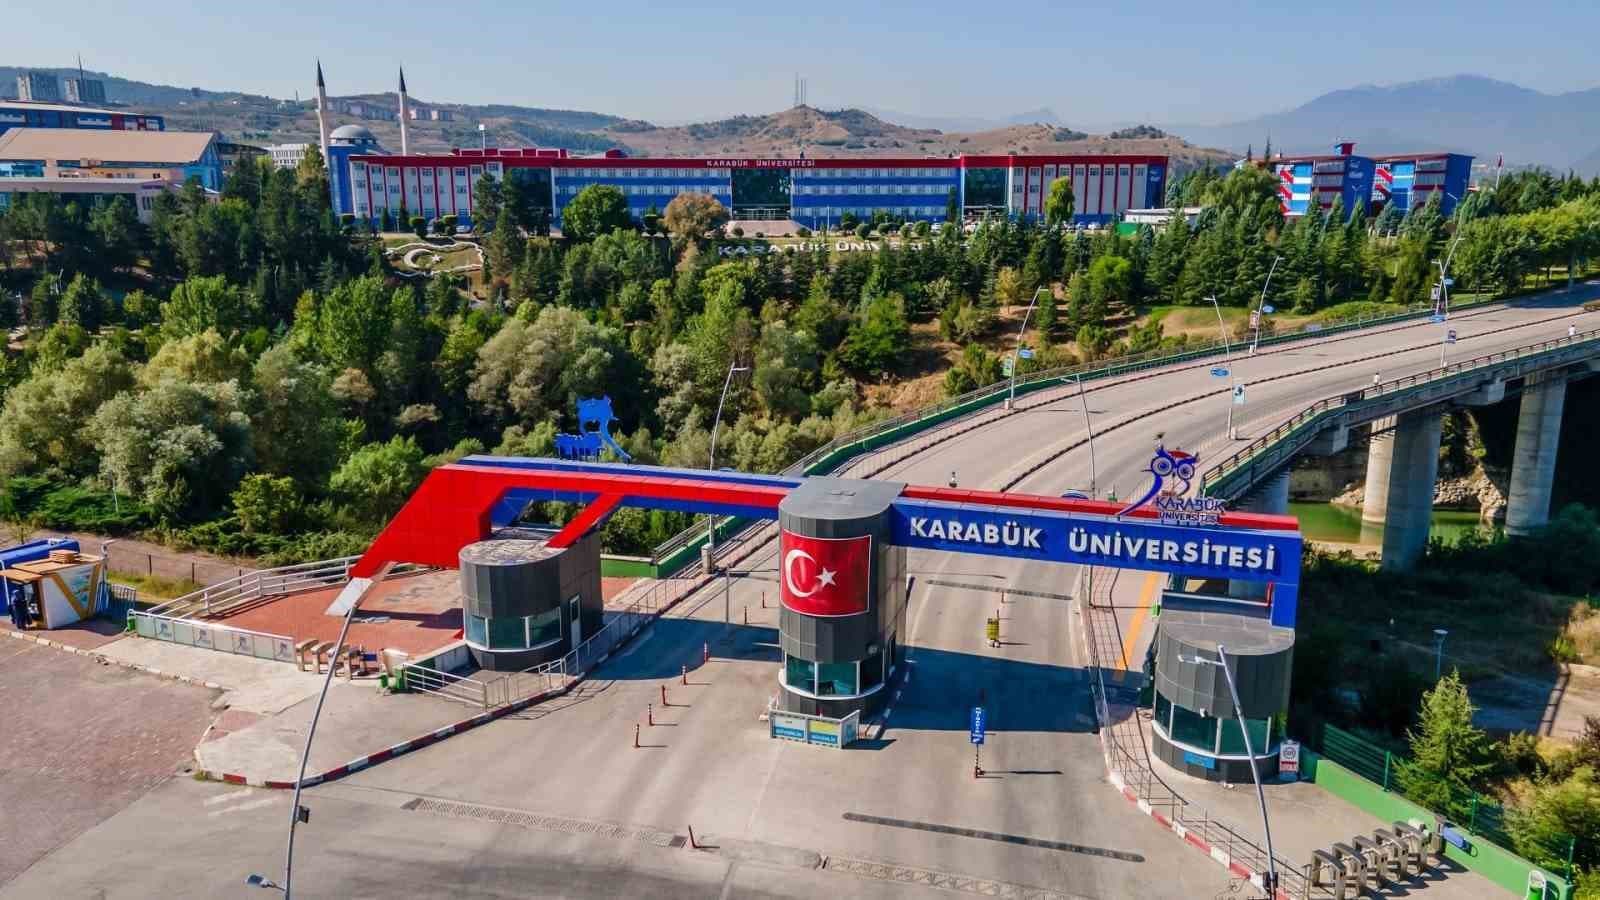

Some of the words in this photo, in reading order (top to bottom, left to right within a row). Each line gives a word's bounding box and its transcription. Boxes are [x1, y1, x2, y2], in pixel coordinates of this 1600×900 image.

[1156, 496, 1225, 512] KARABÜK
[909, 517, 1042, 549] KARABÜK
[1068, 527, 1275, 571] ÜNİVERSİTESİ
